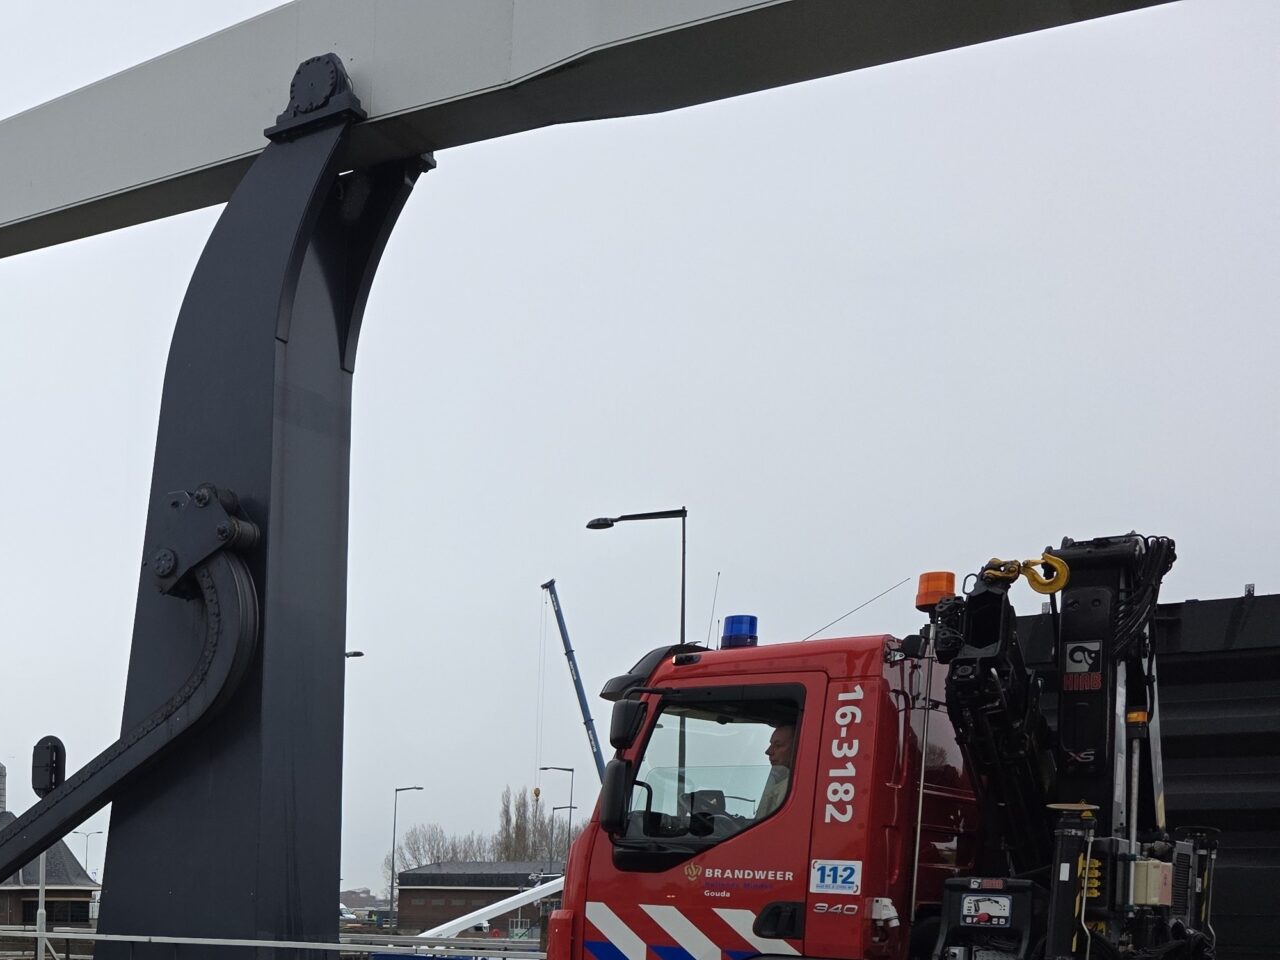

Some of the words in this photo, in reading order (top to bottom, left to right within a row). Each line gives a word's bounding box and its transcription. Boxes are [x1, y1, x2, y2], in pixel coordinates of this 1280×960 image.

[824, 684, 864, 823] 16-3182
[704, 868, 794, 881] BRANDWEER
[816, 865, 856, 885] 1-1-2
[704, 890, 731, 898] Gouda
[813, 902, 859, 915] 340
